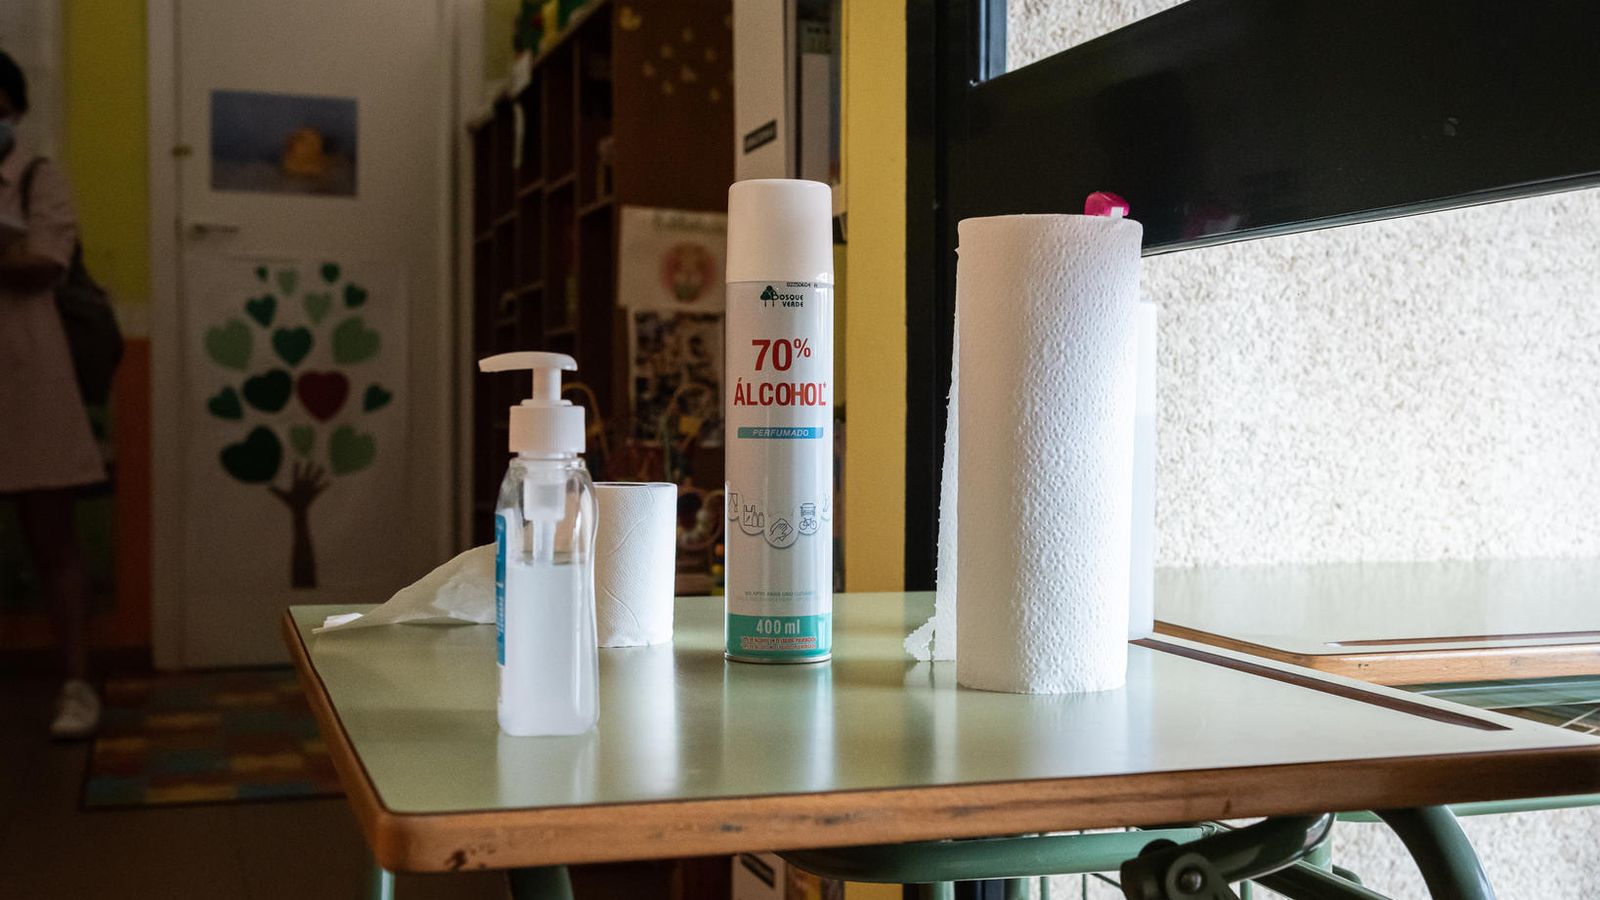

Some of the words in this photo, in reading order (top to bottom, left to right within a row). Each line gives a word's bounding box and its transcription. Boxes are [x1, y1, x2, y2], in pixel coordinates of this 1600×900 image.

[772, 291, 804, 301] BOSQUE
[752, 338, 811, 372] 70%
[752, 429, 809, 437] PERFUMADO
[756, 619, 781, 635] 400
[785, 618, 801, 635] ml
